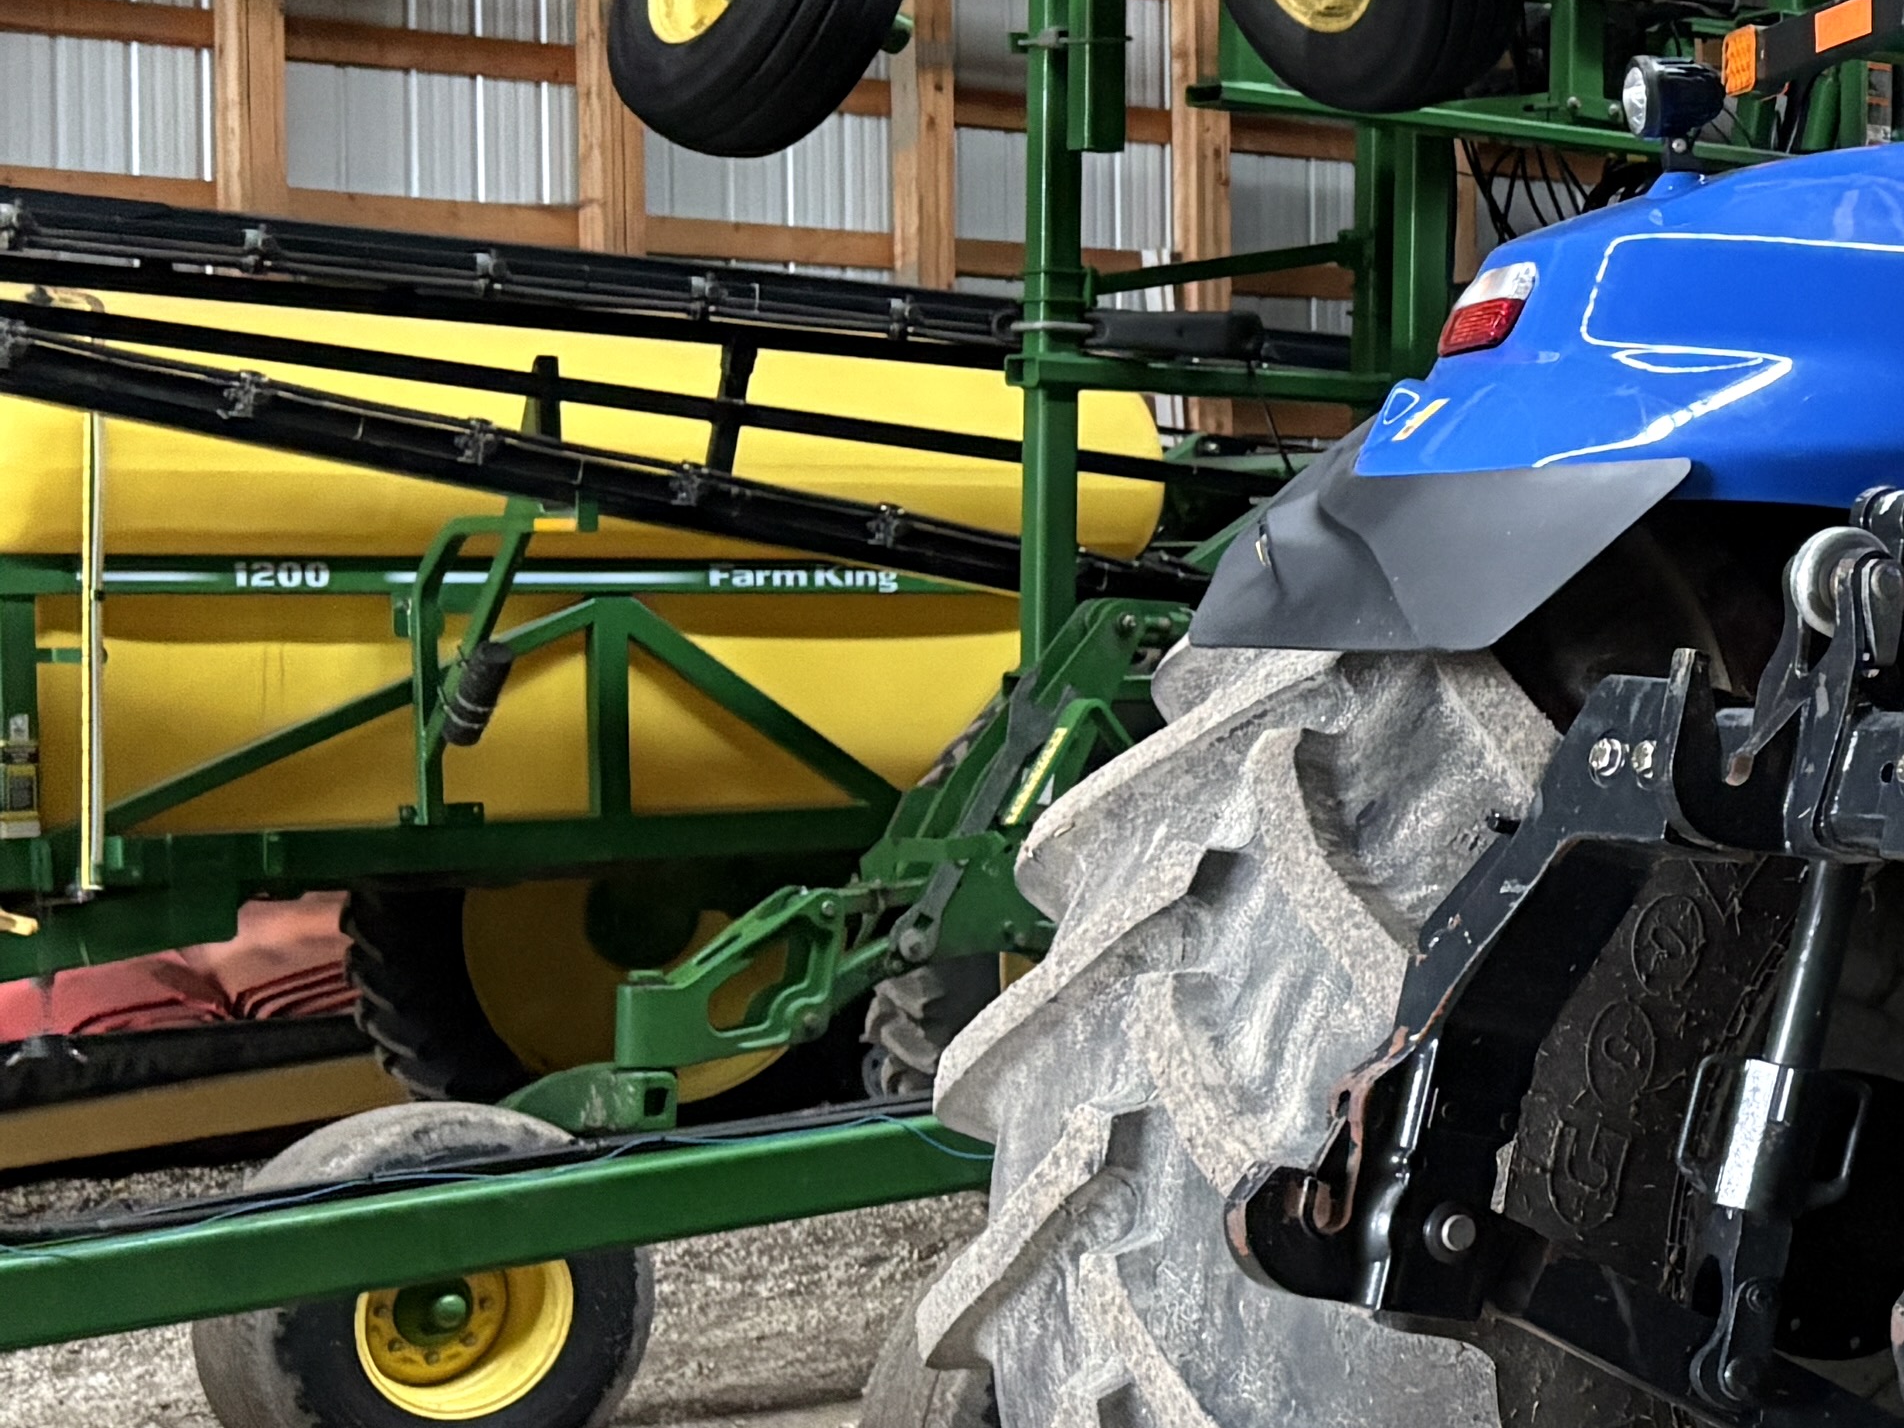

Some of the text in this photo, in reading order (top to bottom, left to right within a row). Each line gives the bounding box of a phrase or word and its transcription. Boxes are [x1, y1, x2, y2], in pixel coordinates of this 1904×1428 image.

[233, 561, 331, 588] 1200
[708, 562, 900, 594] Farm King
